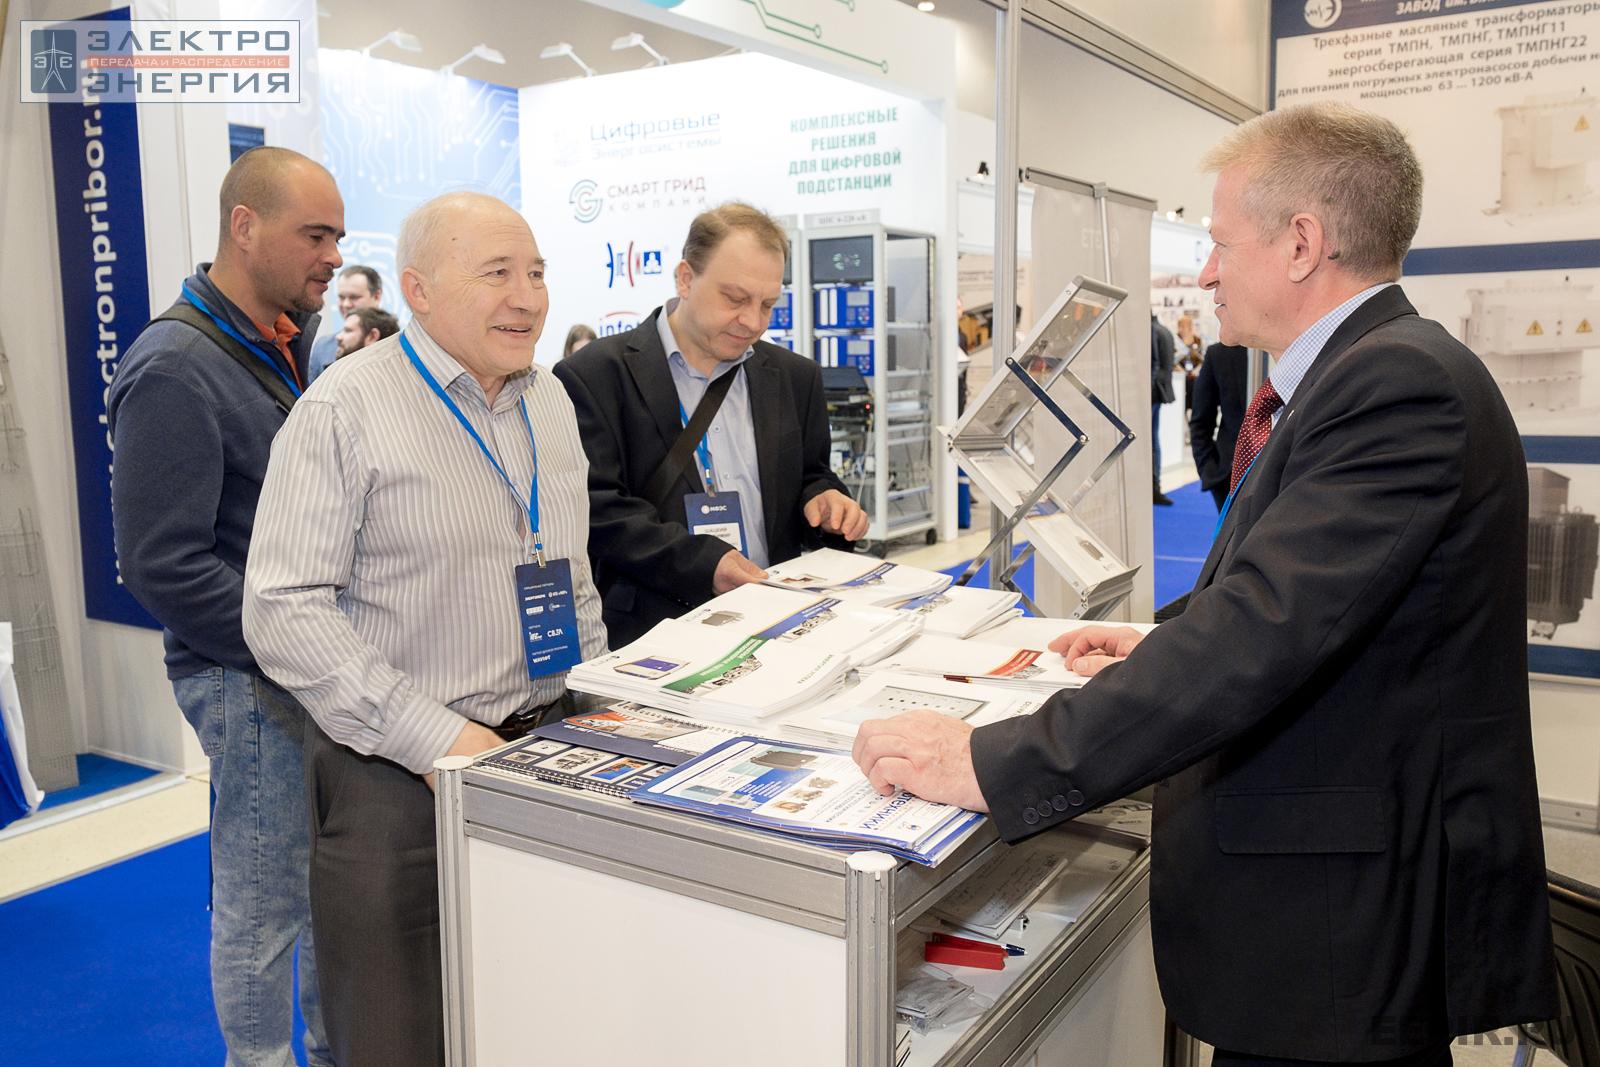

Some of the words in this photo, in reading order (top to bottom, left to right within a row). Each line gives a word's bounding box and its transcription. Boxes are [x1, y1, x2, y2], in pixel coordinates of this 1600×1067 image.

[1396, 0, 1440, 15] ЗАВОД
[1313, 30, 1392, 49] Трехфазные
[1400, 18, 1468, 37] масляные
[1344, 46, 1382, 60] серии
[1389, 40, 1433, 55] ТМПН,
[1440, 31, 1492, 47] ТМПНГ,
[1498, 21, 1566, 40] ТМПНГ11
[1328, 52, 1464, 77] энергосберегающая
[1470, 47, 1512, 62] серия
[1516, 35, 1588, 54] ТМПНГ22
[1277, 89, 1299, 98] для
[1302, 82, 1349, 93] питания
[1352, 74, 1421, 88] погружных
[1424, 61, 1528, 80] электронасосов
[1532, 54, 1587, 68] добычи
[1360, 84, 1432, 99] мощностью
[1438, 80, 1453, 90] 63
[1471, 76, 1501, 88] 1200
[591, 112, 721, 143] Цифровые
[790, 106, 898, 132] КОМПЛЕКСНЫЕ
[811, 131, 876, 152] РЕШЕНИЯ
[788, 158, 817, 177] ДЛЯ
[821, 147, 902, 173] ЦИФРОВОЙ
[607, 180, 660, 199] СМАРТ
[664, 175, 707, 193] ГРИД
[797, 173, 893, 195] ПОДСТАНЦИИ
